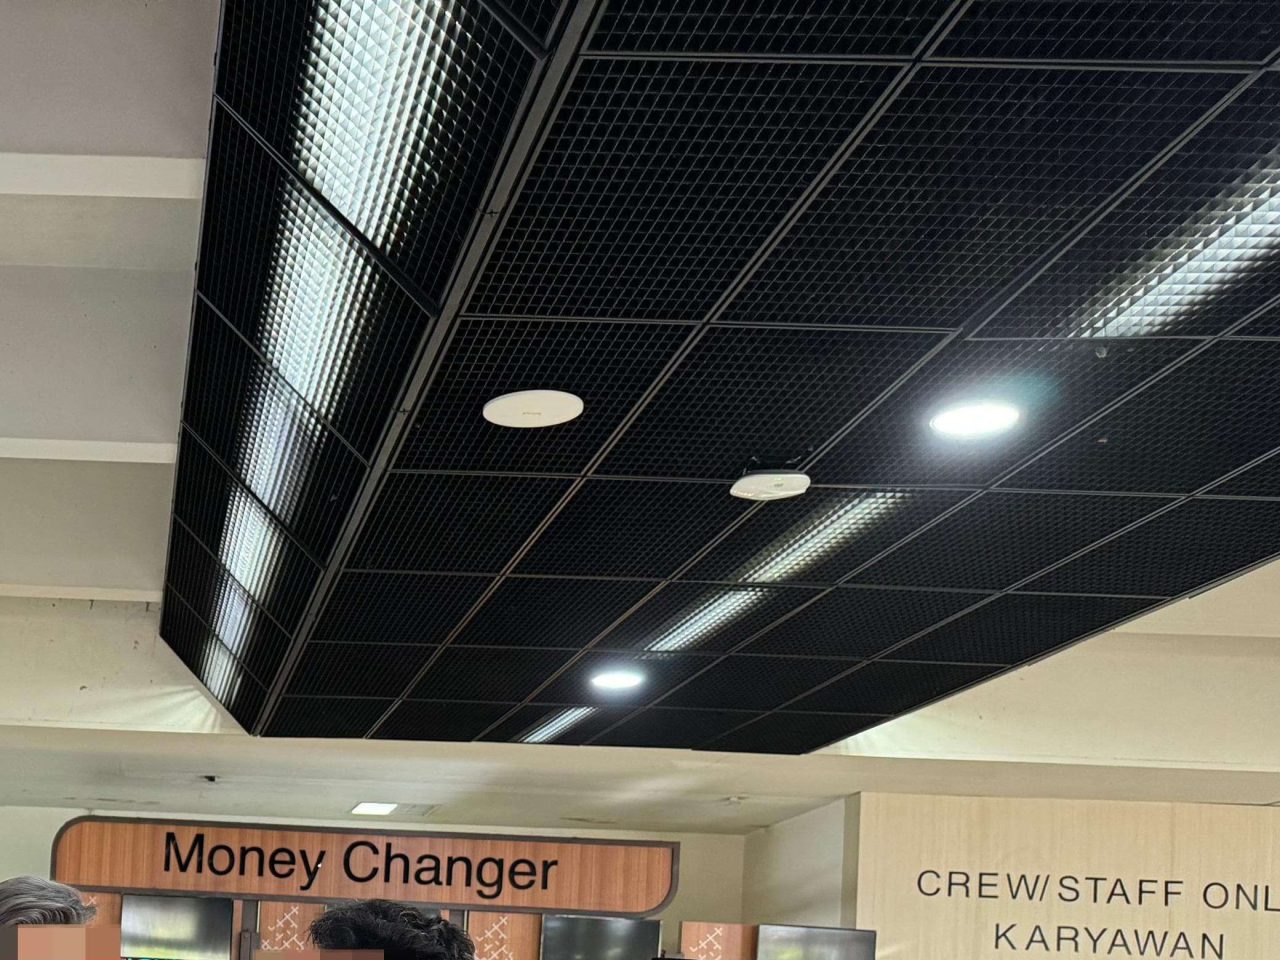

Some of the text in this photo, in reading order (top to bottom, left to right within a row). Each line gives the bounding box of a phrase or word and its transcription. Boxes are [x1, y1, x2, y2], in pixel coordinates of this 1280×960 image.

[163, 831, 559, 899] Money Changer
[993, 922, 1225, 960] KARYAWAN
